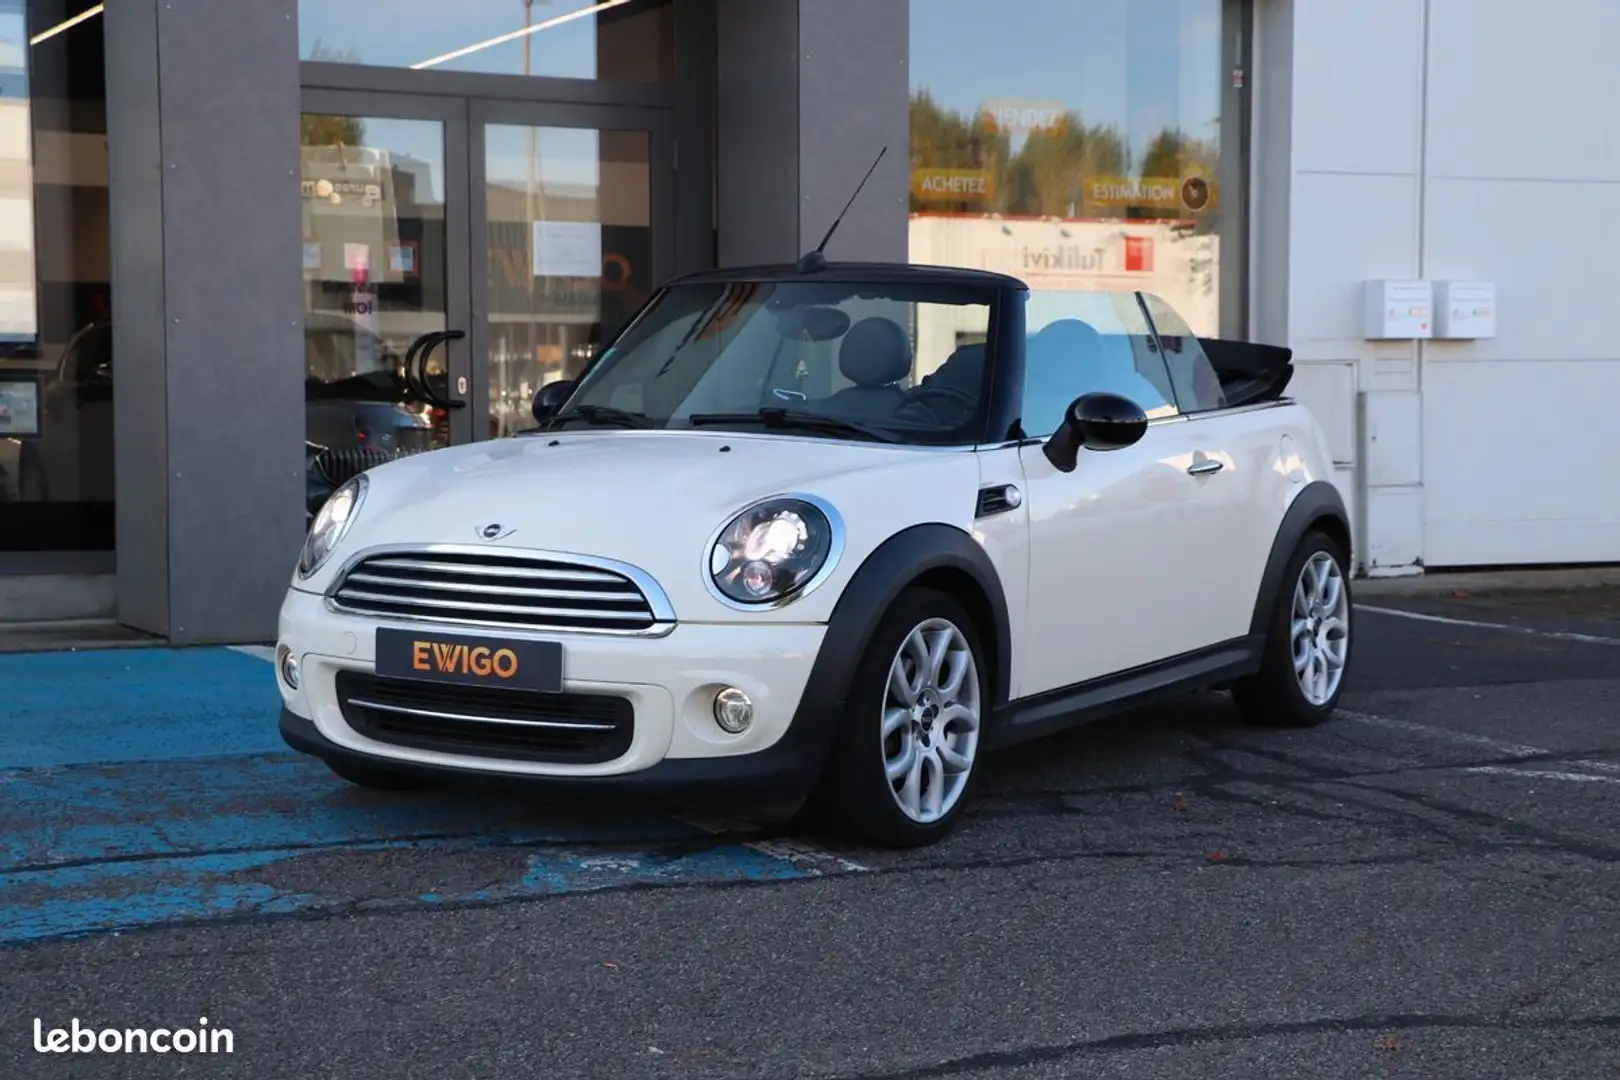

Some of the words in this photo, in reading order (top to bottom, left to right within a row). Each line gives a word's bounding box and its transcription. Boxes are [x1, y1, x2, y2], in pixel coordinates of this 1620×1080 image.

[921, 175, 986, 194] ACHETEZ
[1093, 183, 1175, 200] ESTIMATION
[413, 640, 518, 678] EWIGO
